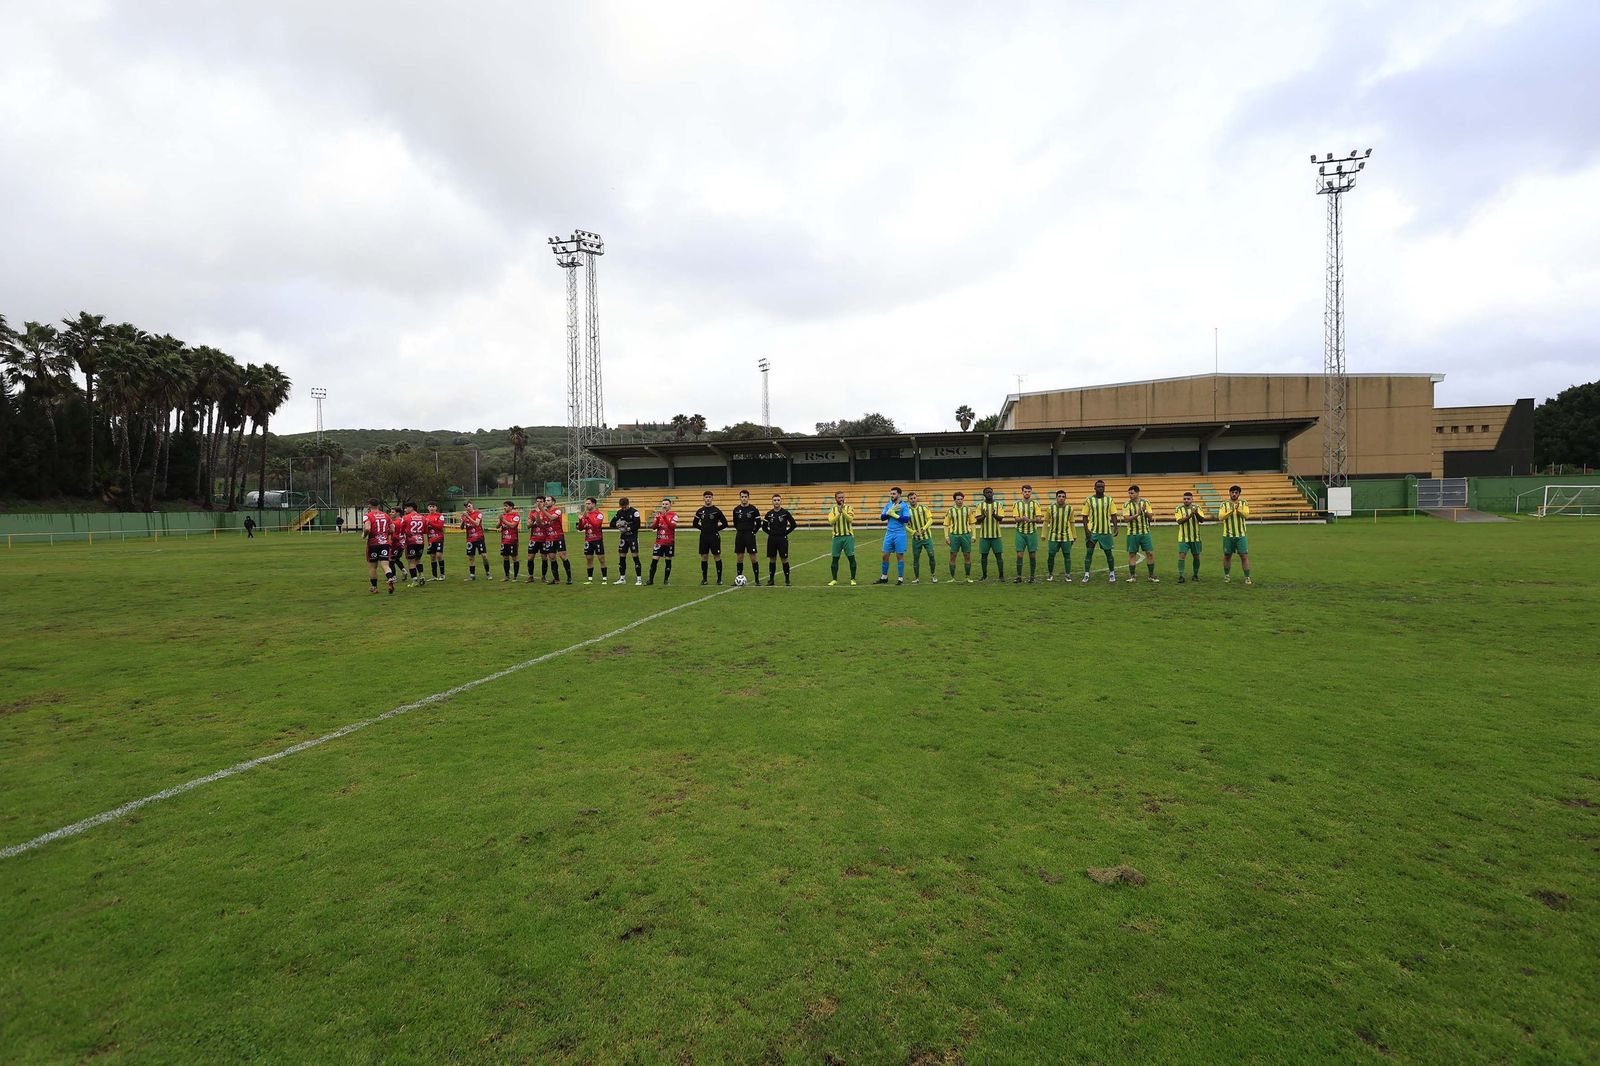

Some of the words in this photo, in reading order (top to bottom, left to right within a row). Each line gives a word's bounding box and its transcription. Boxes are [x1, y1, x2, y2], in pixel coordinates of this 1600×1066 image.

[804, 451, 836, 461] RSG
[932, 446, 968, 457] RSG
[375, 519, 387, 532] 17
[410, 520, 424, 533] 22
